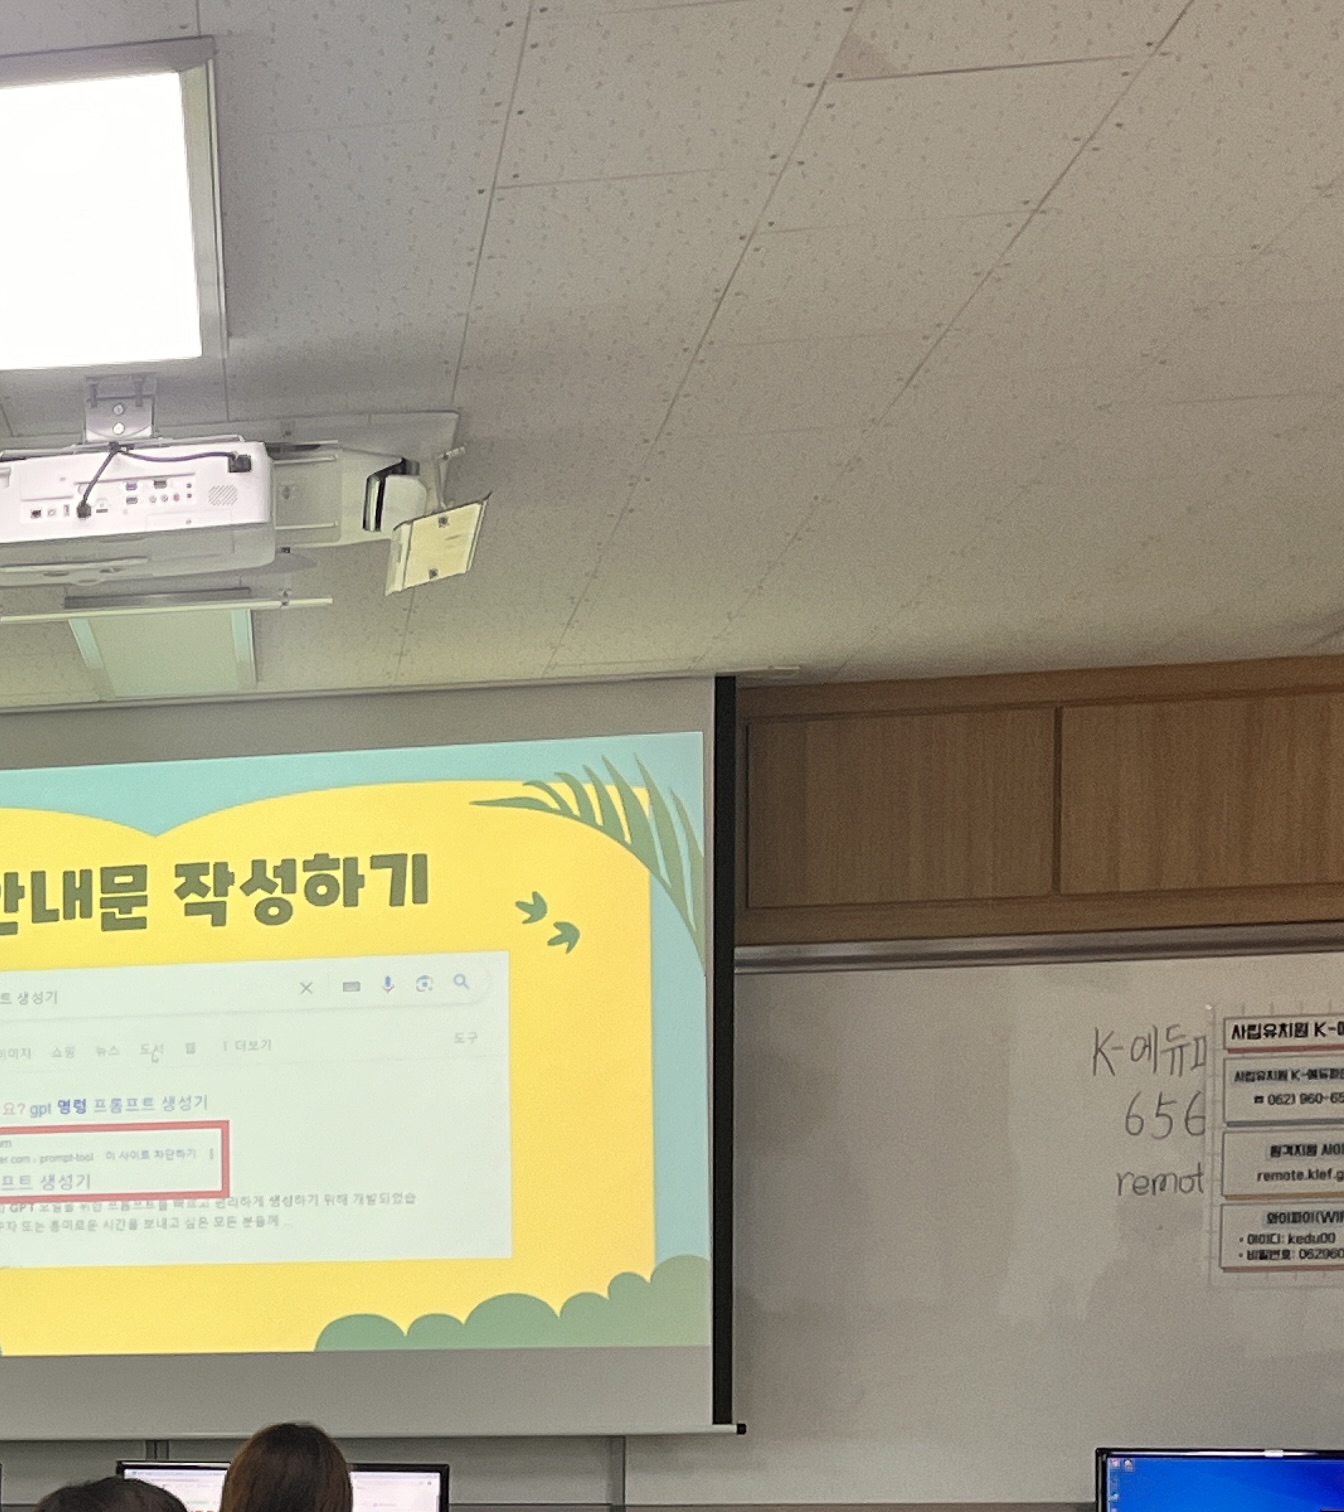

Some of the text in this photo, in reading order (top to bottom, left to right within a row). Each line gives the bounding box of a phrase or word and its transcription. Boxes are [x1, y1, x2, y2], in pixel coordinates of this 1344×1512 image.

[174, 853, 428, 927] 작성하기
[17, 991, 58, 1005] 생성기
[1232, 1022, 1309, 1040] 사립유치원
[235, 1039, 272, 1052] 더보기
[454, 1032, 479, 1045] 도구
[1234, 1070, 1287, 1082] 사립유치원
[29, 1103, 52, 1118] gpt
[57, 1099, 87, 1114] 명령
[93, 1097, 155, 1114] 프롬프트
[162, 1095, 208, 1112] 생성기
[153, 1148, 196, 1160] 차단하기
[40, 1173, 92, 1191] 생성기
